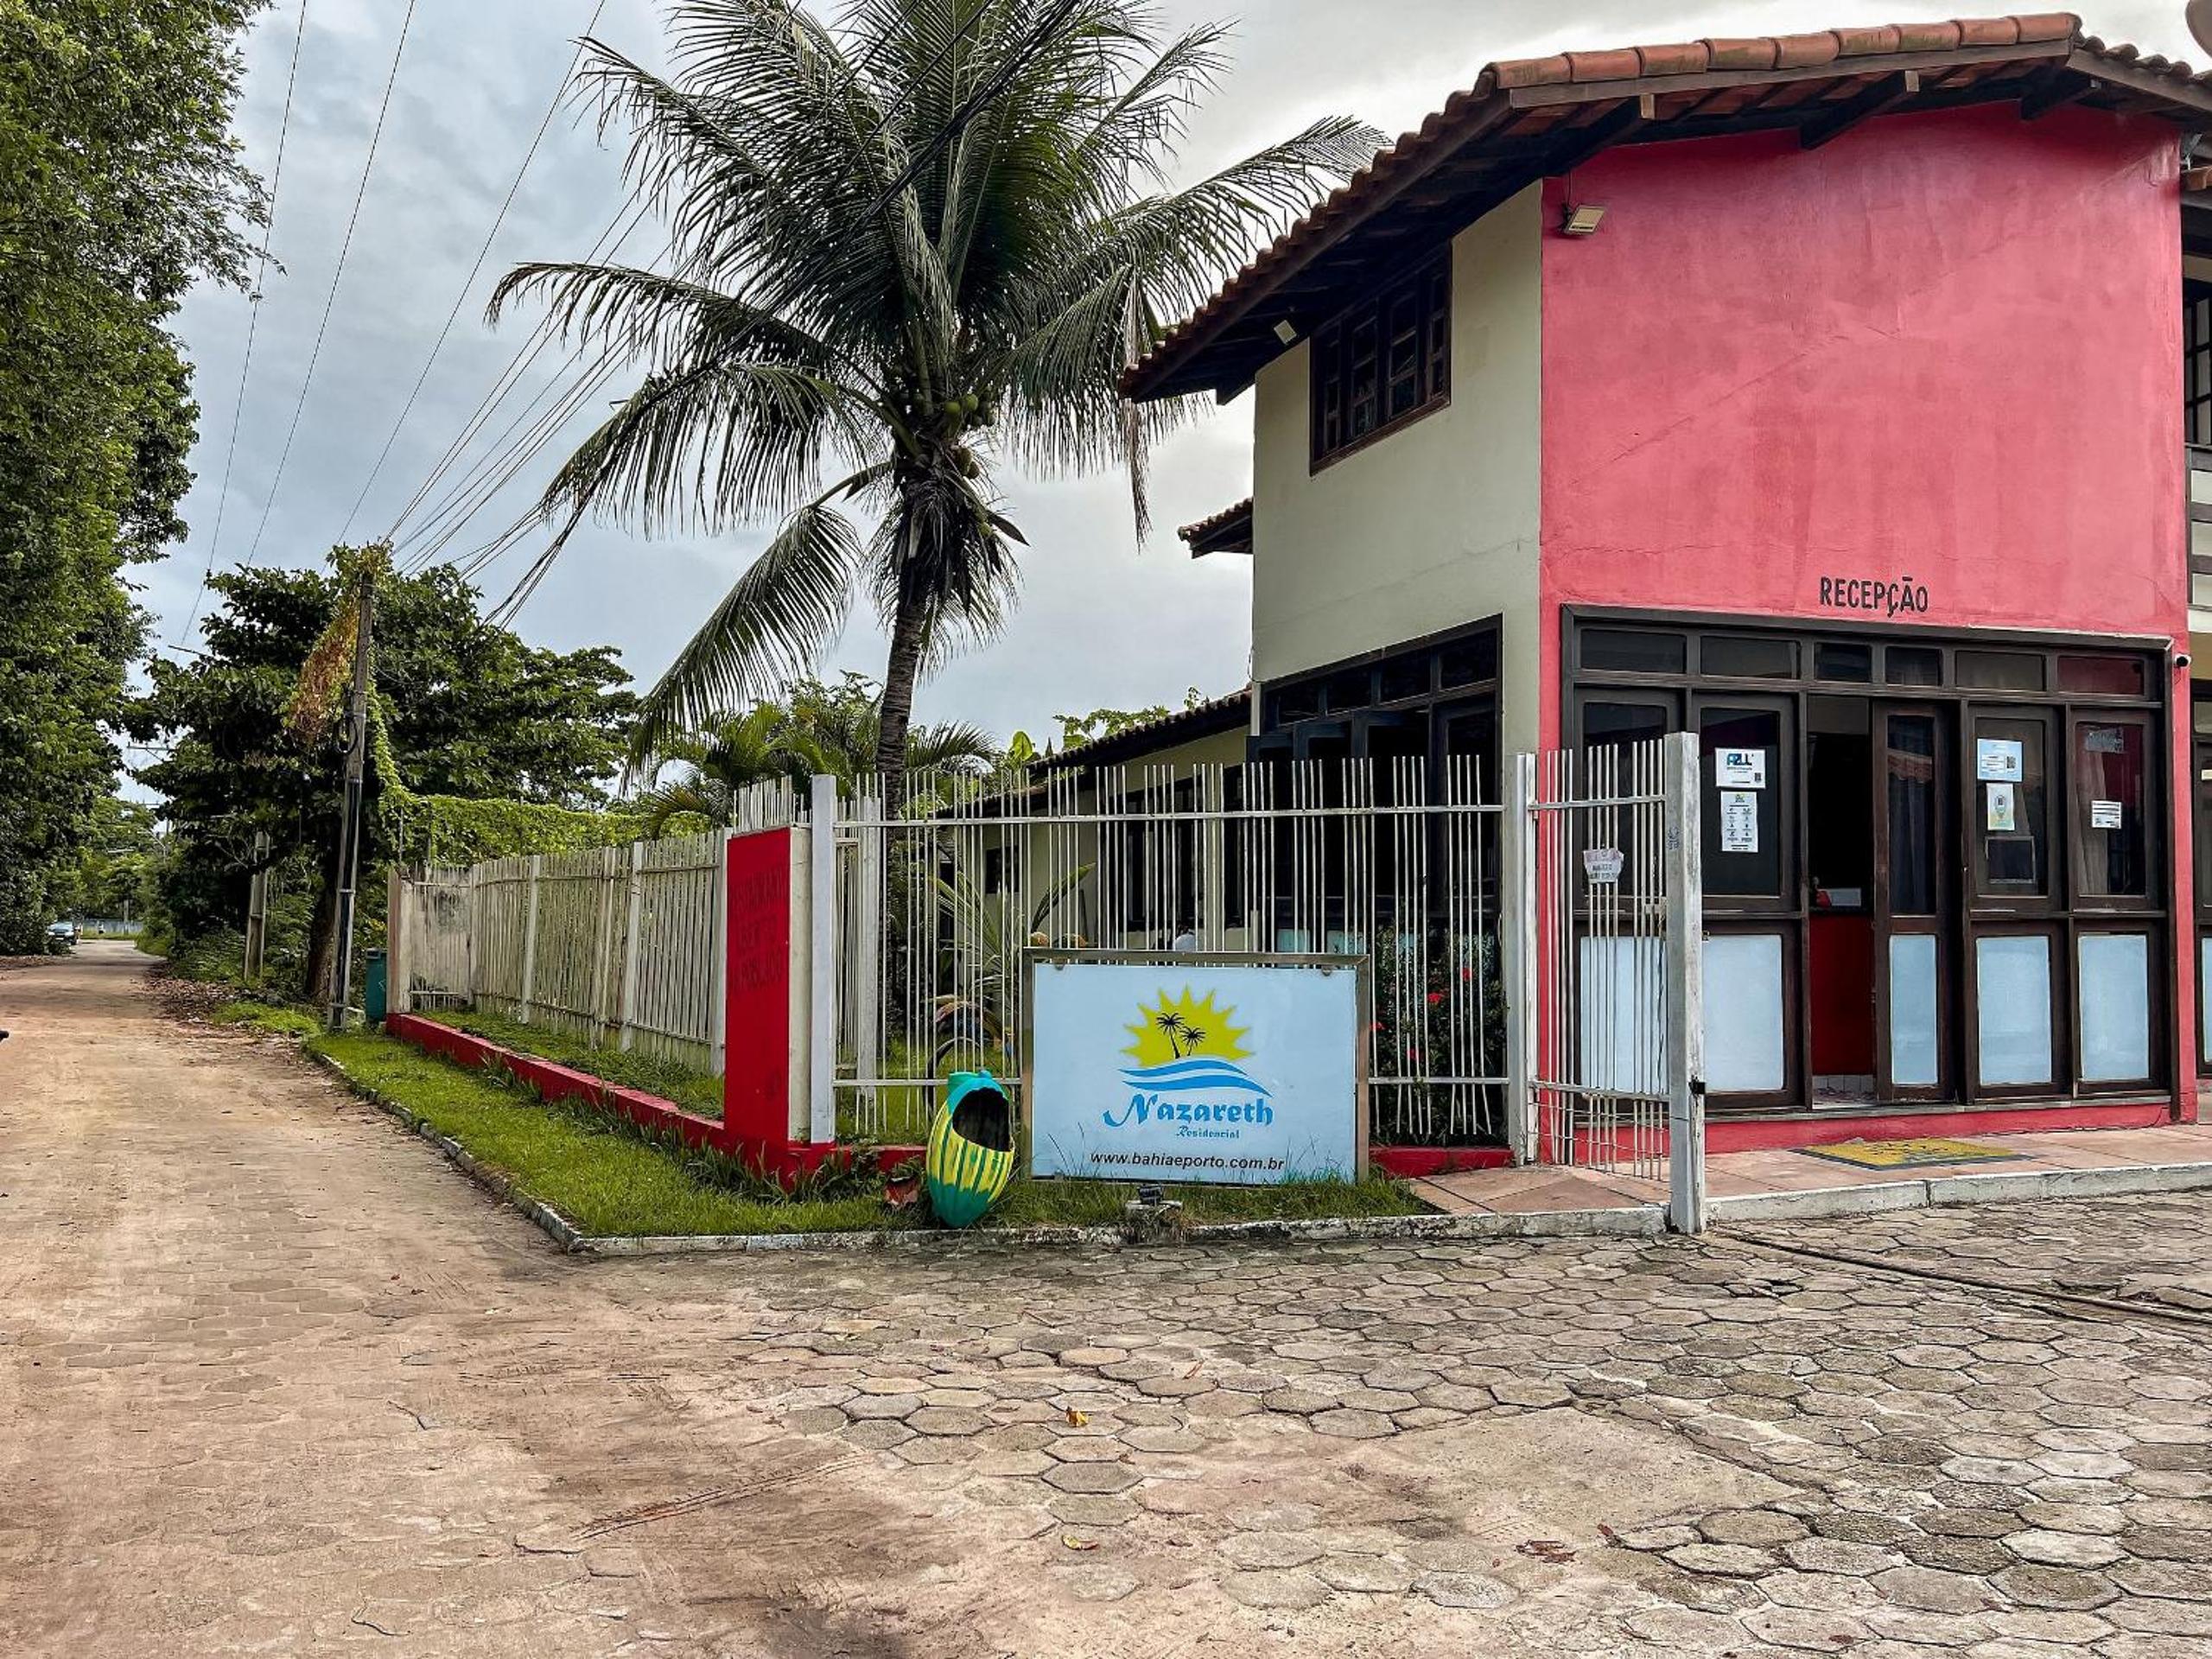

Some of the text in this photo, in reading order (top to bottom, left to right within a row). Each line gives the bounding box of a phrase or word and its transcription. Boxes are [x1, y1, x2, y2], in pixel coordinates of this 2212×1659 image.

[1820, 576, 1929, 618] RECEPÇÃO
[1103, 1094, 1274, 1127] Nazareth
[1176, 1125, 1240, 1139] Residencial
[1090, 1152, 1285, 1170] www.bahiaeporto.com.br
